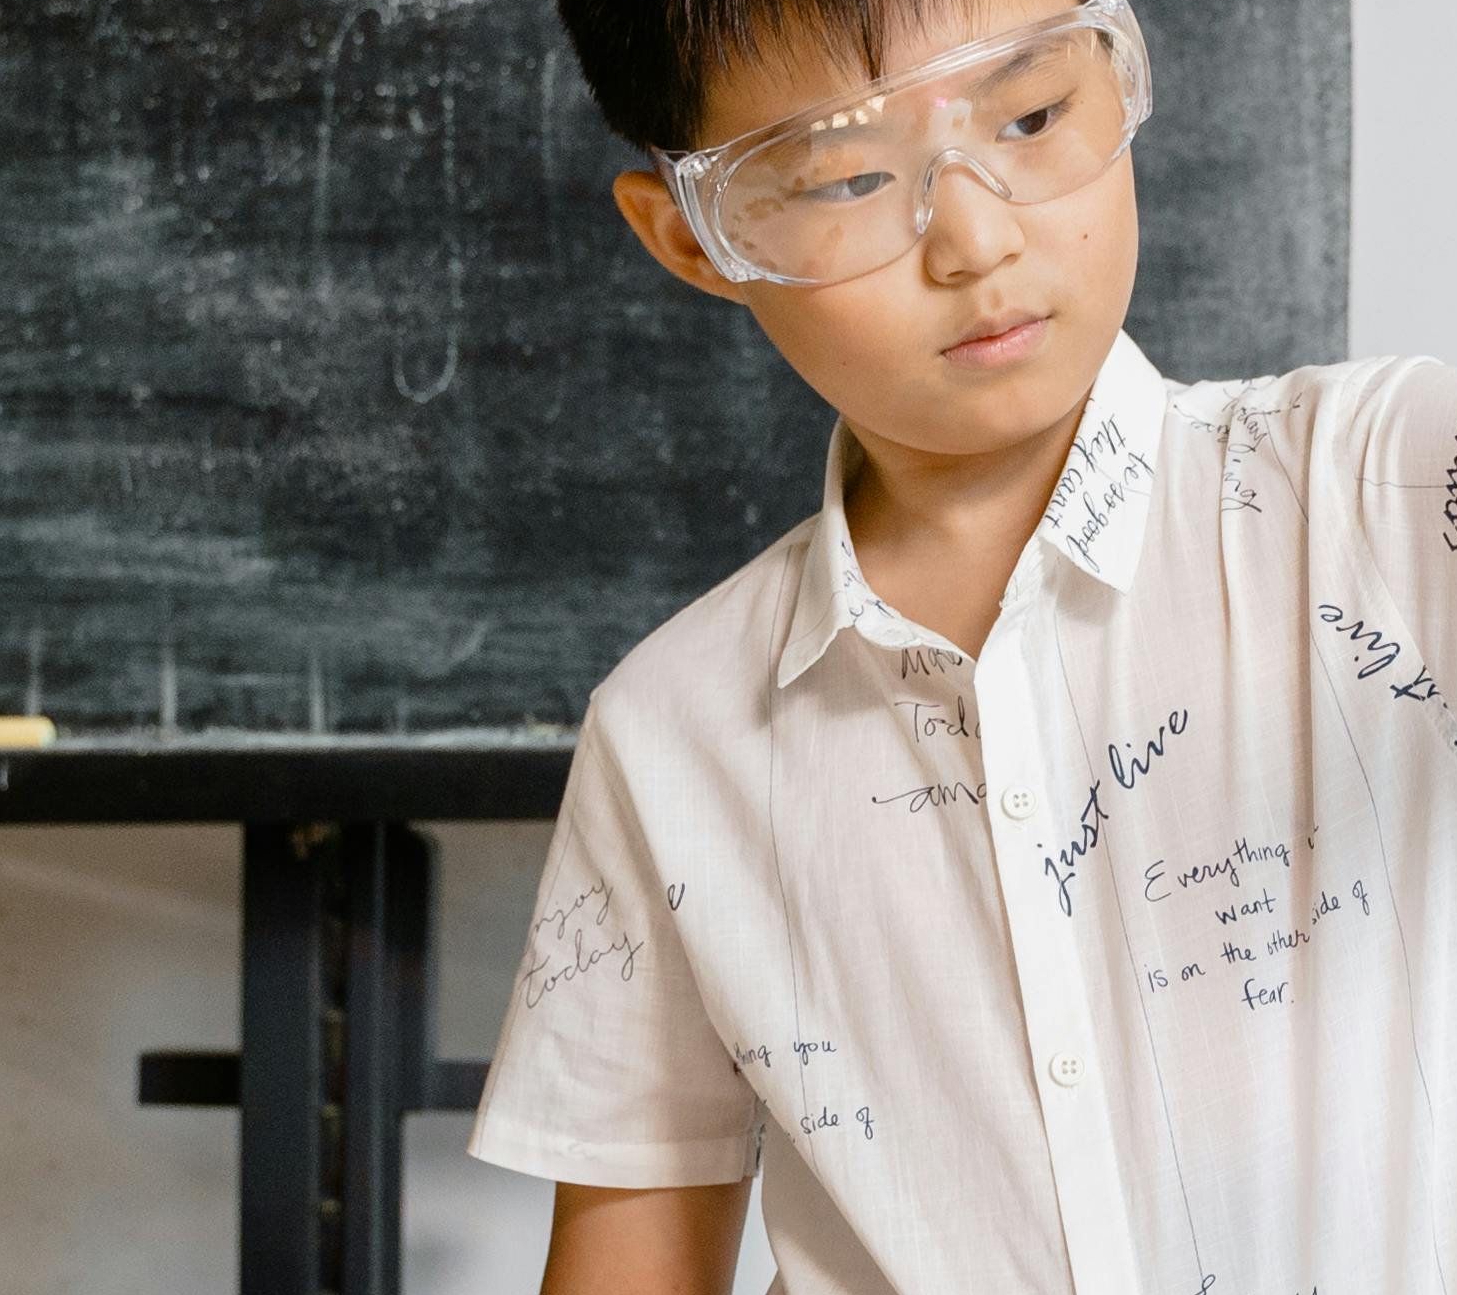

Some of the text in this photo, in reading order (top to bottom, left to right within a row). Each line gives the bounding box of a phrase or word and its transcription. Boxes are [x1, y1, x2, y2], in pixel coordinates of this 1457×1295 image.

[1065, 491, 1110, 573] good
[1318, 604, 1401, 681] live
[1036, 708, 1189, 917] just live
[1144, 836, 1291, 903] Everything
[1143, 879, 1371, 993] is on the other side of
[1215, 888, 1277, 926] want
[793, 1040, 838, 1066] you
[800, 1106, 875, 1141] side of
